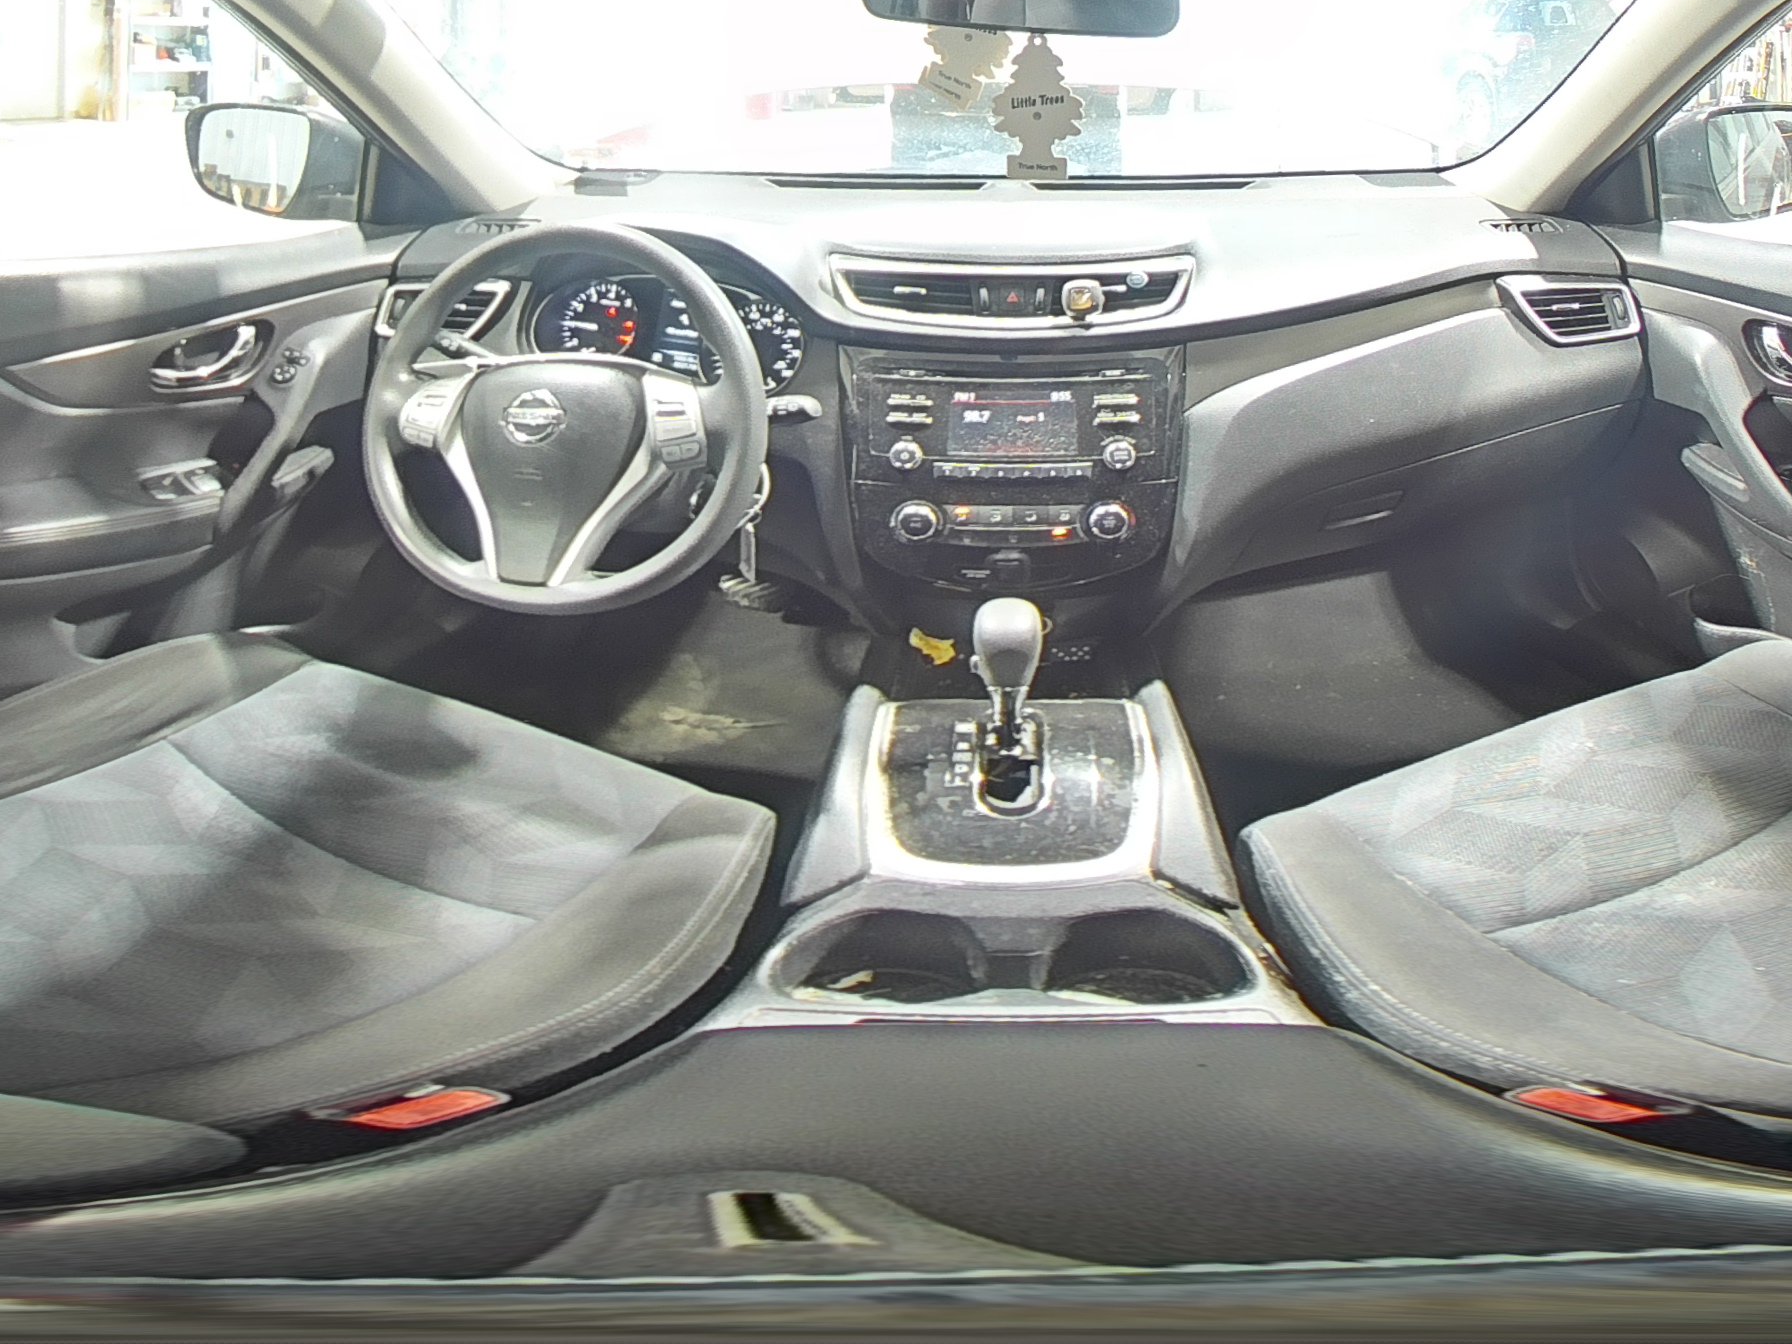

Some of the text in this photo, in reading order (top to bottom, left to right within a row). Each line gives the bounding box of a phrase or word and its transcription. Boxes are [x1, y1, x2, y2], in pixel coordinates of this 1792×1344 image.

[953, 77, 972, 90] North
[1011, 94, 1064, 109] Little Trees
[1018, 161, 1058, 171] True North
